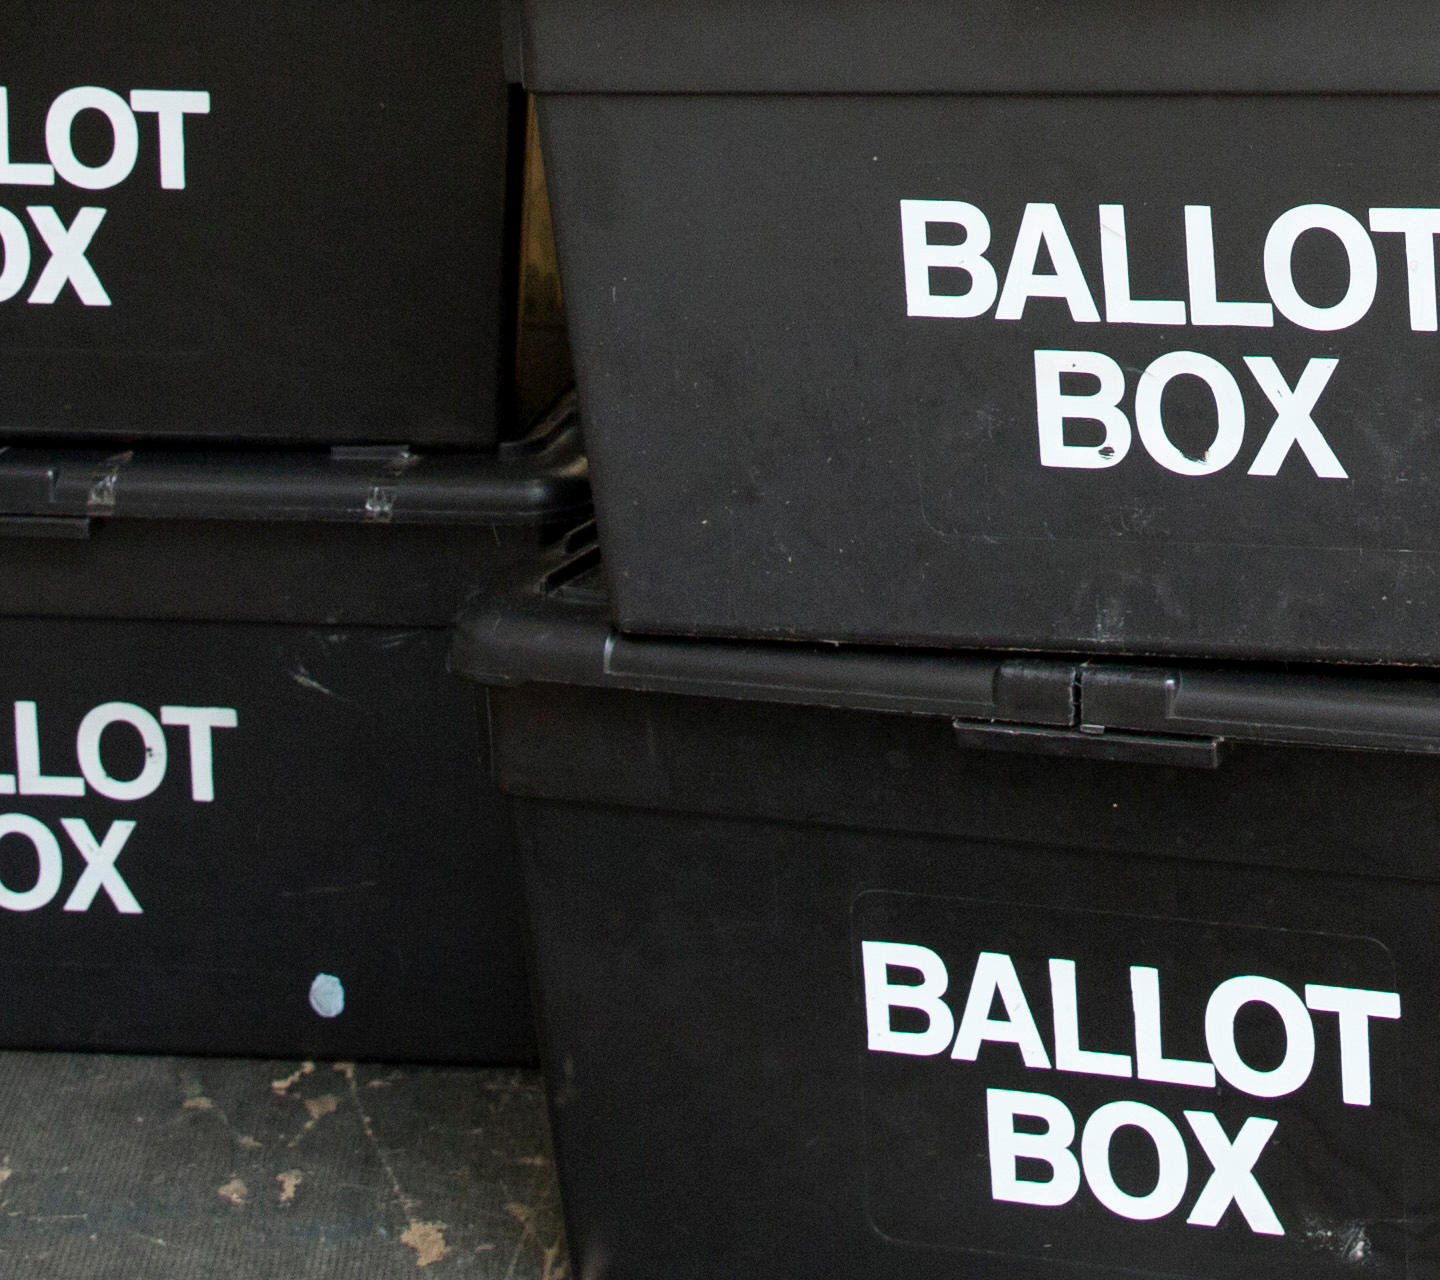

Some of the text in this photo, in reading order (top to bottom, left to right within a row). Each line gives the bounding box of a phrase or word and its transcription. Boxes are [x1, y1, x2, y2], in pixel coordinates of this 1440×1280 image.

[1034, 350, 1348, 478] BOX
[862, 941, 1401, 1106] BALLOT
[987, 1088, 1285, 1235] BOX
